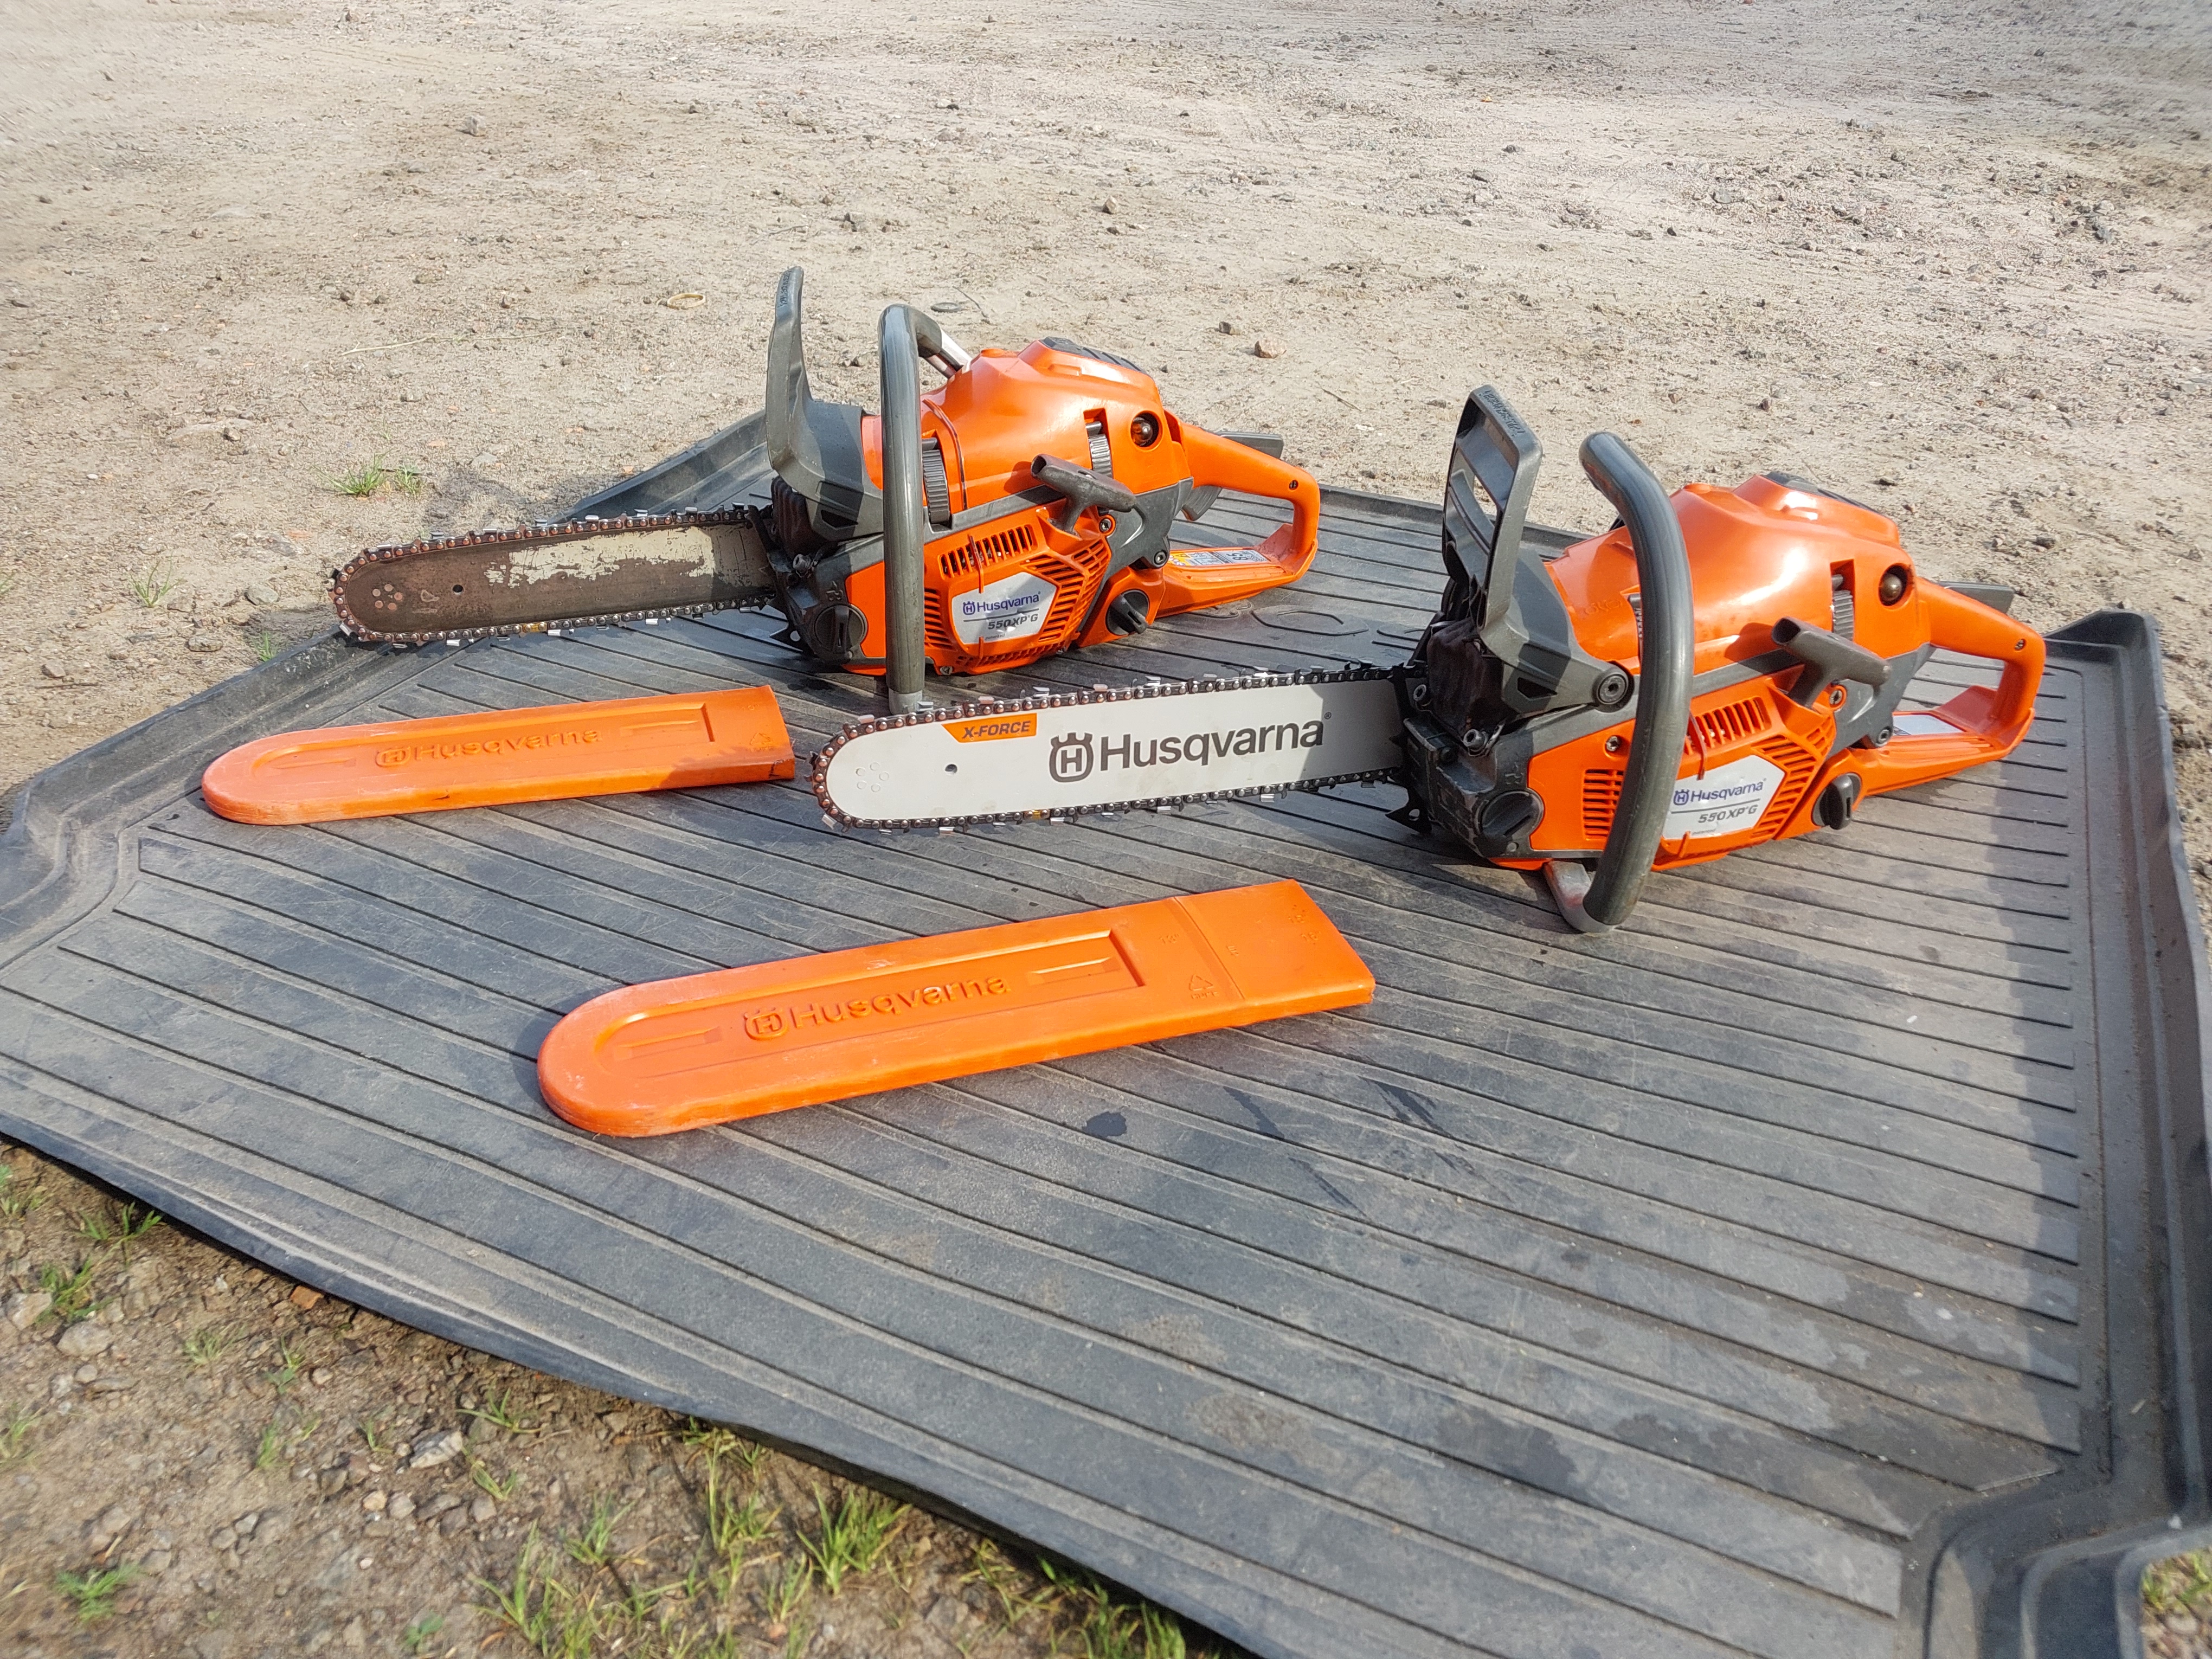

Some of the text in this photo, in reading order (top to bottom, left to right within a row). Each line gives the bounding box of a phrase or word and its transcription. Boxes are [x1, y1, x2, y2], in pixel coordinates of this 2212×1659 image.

[414, 729, 602, 760] Husqvarna
[962, 721, 1031, 739] X-FORCE
[790, 976, 1012, 1028] Husqvarna
